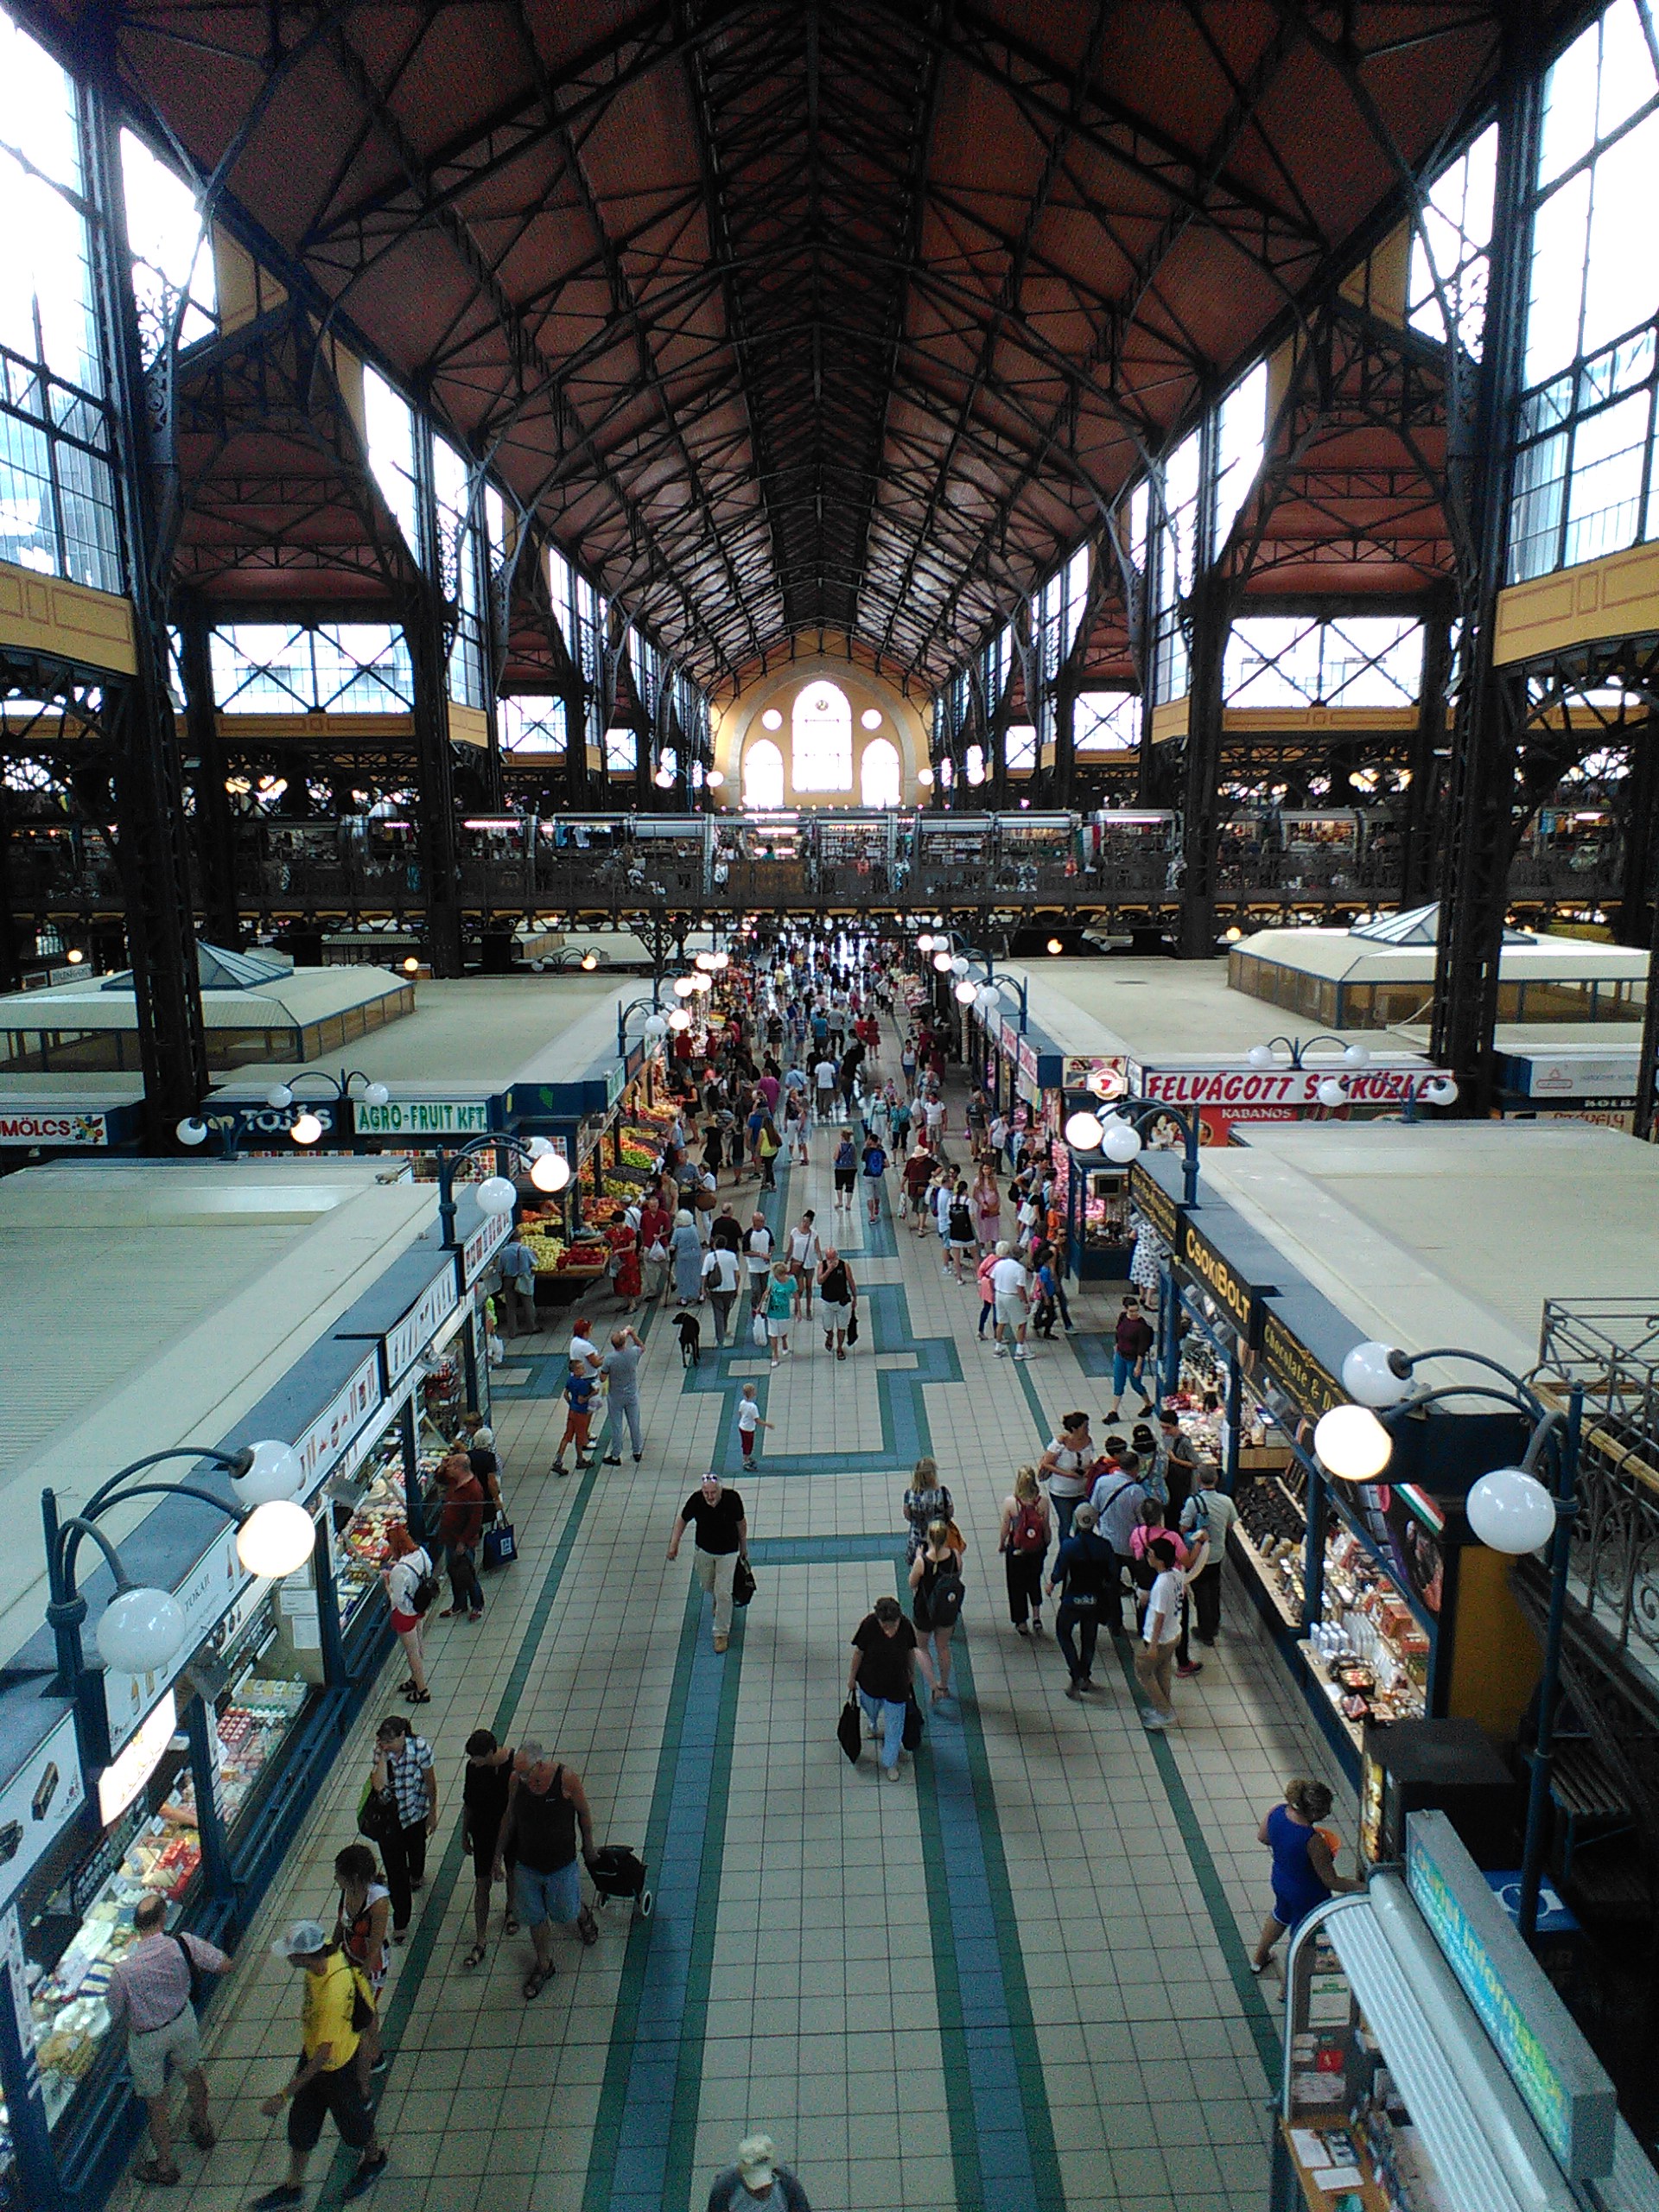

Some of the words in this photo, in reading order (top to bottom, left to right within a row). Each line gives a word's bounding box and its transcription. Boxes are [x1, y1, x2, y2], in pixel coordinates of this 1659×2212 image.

[1148, 1072, 1295, 1102] FELVÁGOTT
[1303, 1071, 1450, 1101] SKÜZLE
[359, 1104, 453, 1130] AGRO-FRUIT
[457, 1105, 487, 1130] KFT.
[1221, 1108, 1293, 1119] KABANOS
